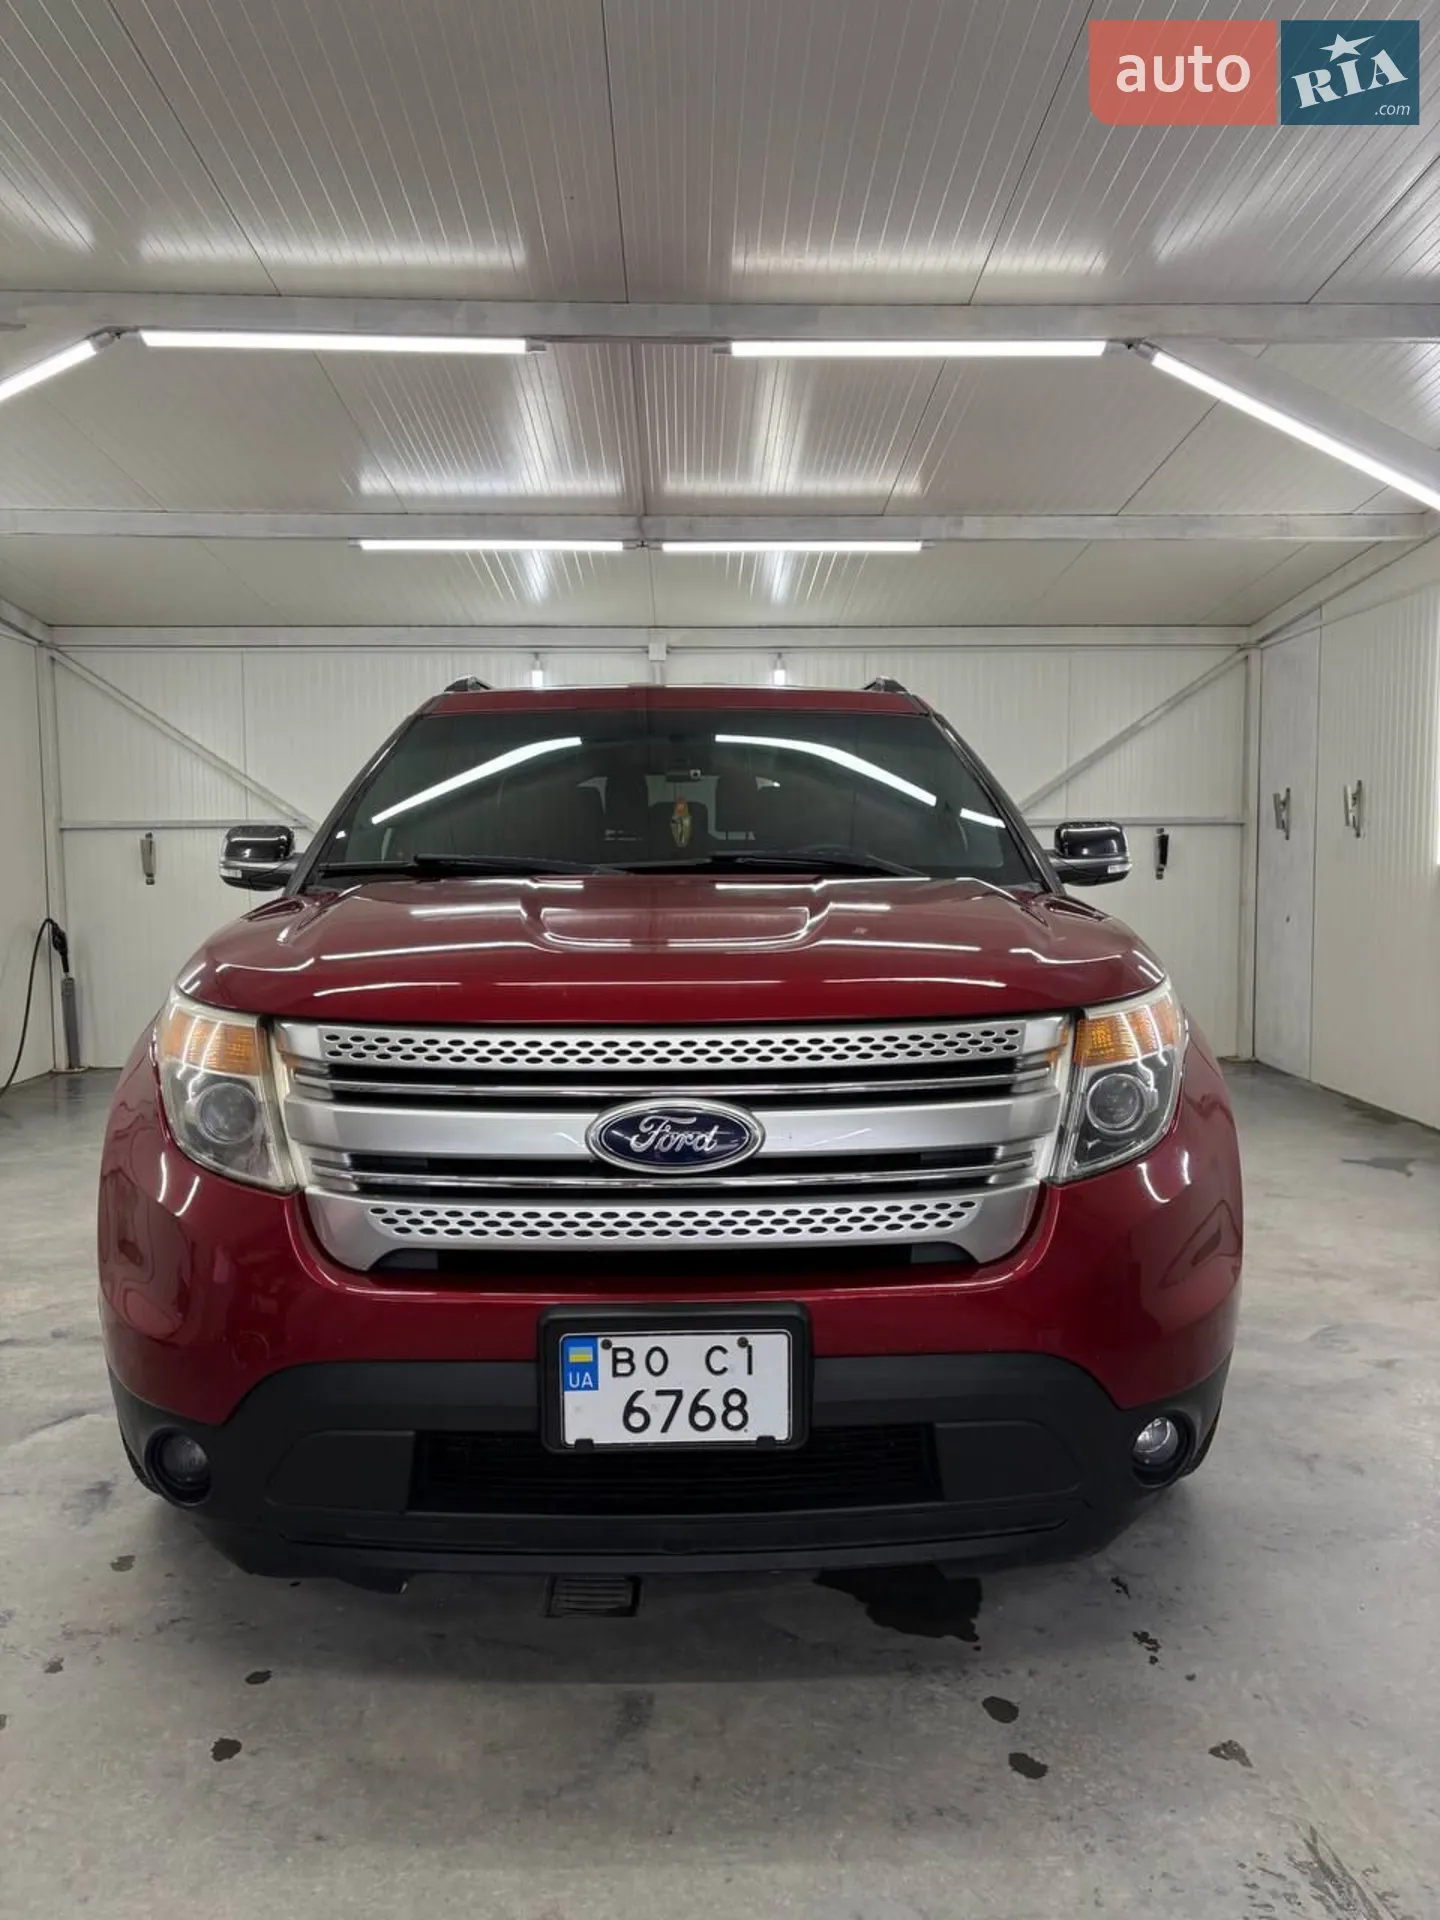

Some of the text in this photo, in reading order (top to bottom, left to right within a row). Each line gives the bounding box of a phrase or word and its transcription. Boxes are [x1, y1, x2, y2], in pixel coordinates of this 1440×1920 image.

[611, 1115, 738, 1152] Ford
[569, 1372, 594, 1389] UA
[622, 1387, 749, 1434] 6768
